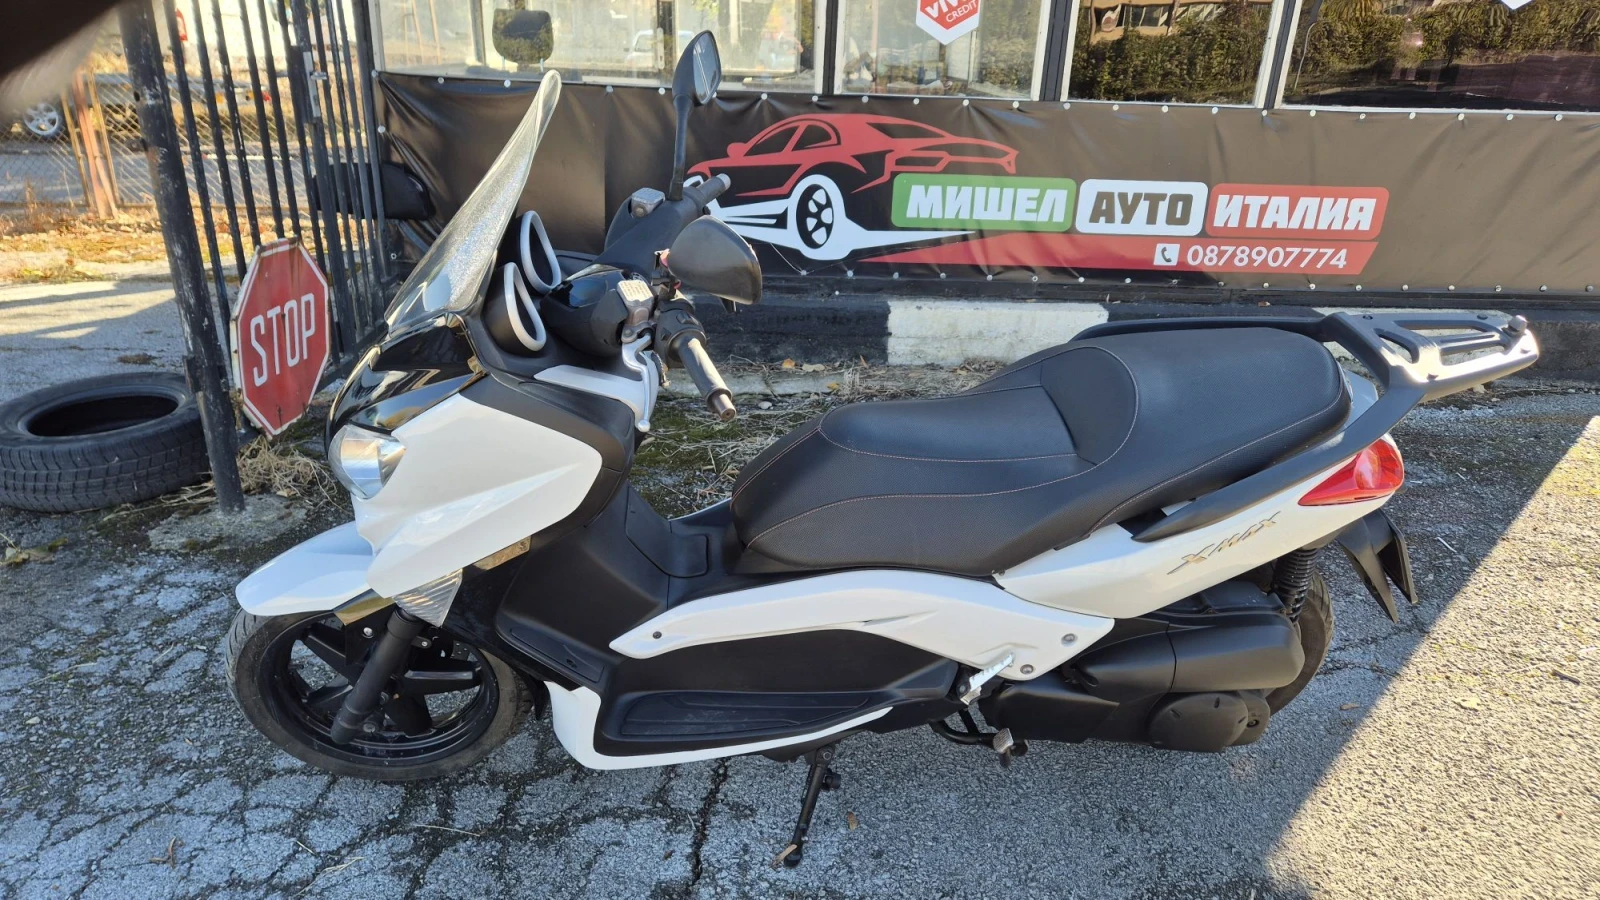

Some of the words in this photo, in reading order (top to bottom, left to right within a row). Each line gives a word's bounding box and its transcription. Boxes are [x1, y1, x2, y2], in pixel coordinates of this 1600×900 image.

[946, 0, 977, 22] CREDIT
[906, 184, 1068, 222] МИШЕЛ
[1089, 191, 1194, 226] АУТО
[1213, 194, 1377, 231] ИТАЛИЯ
[1186, 245, 1348, 269] 0878907774
[250, 293, 315, 387] STOP
